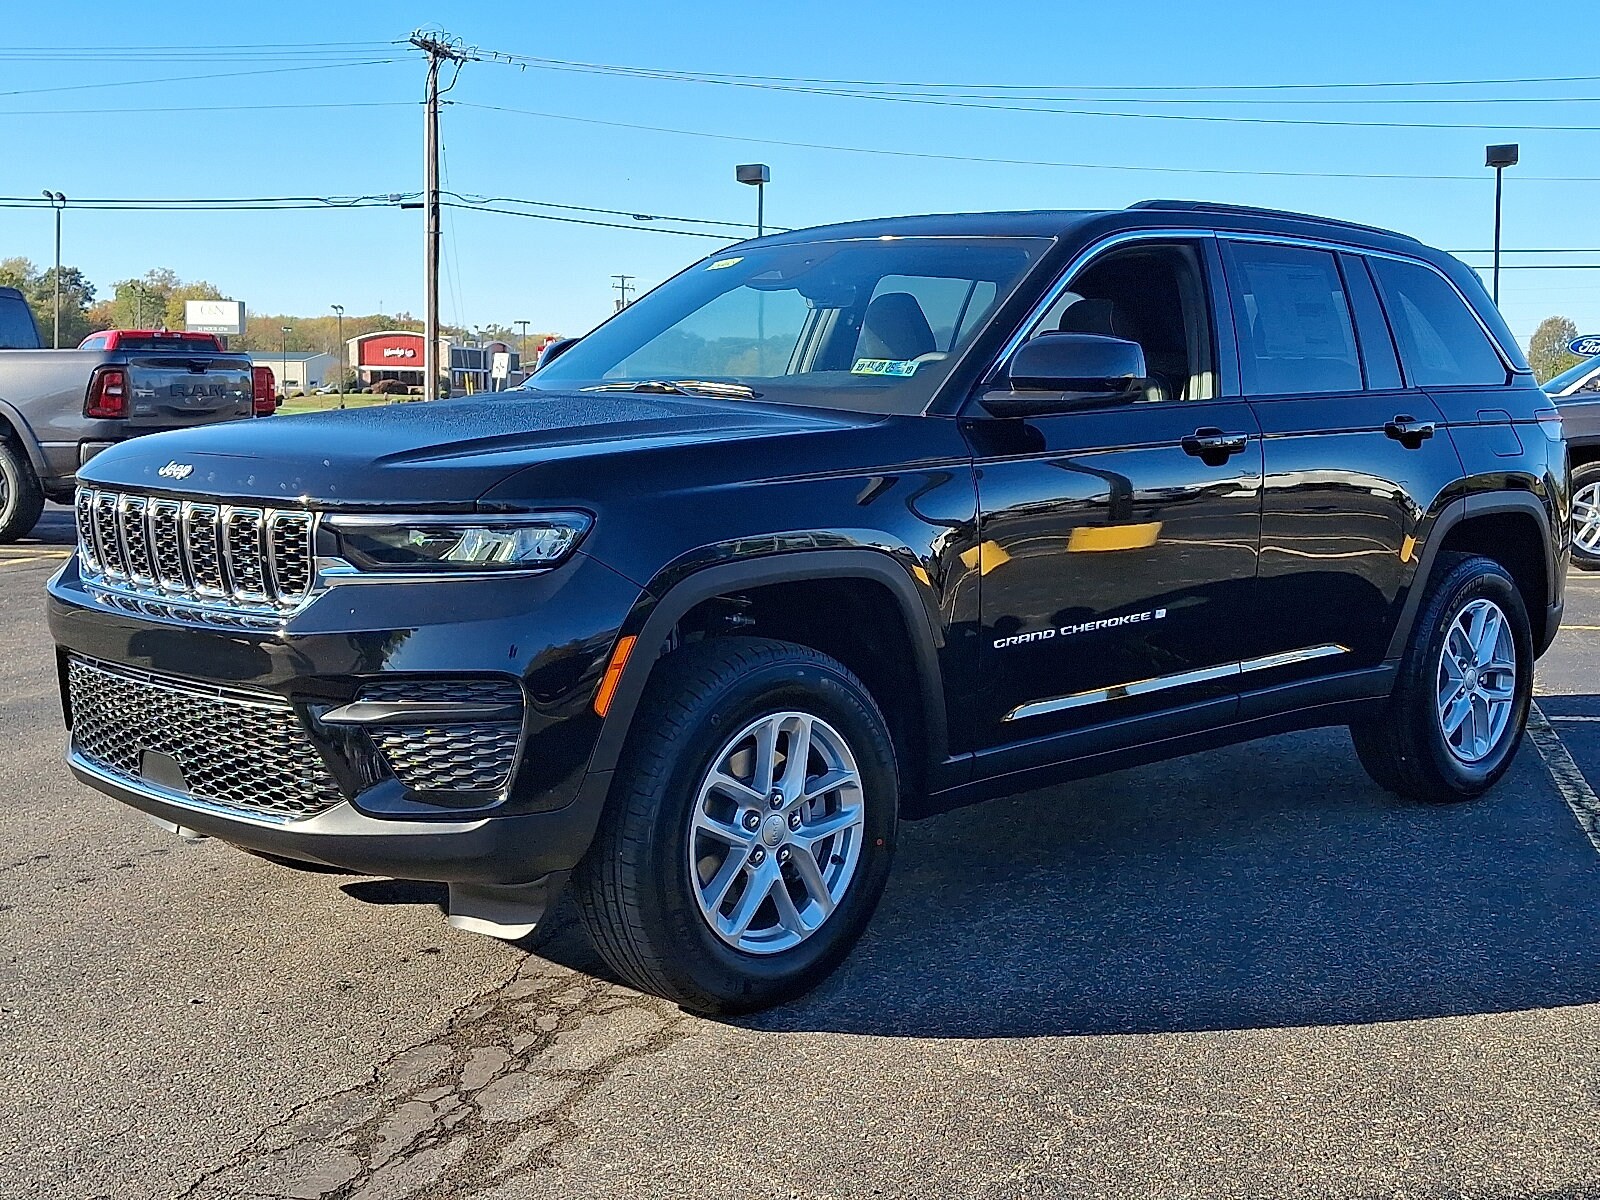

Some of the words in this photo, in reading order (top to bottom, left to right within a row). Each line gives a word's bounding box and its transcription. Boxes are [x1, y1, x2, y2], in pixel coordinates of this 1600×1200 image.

[1578, 340, 1600, 353] For
[169, 384, 226, 397] RAM
[158, 460, 194, 480] Jeep
[993, 629, 1056, 649] GRAND
[1060, 611, 1152, 636] CHEROKEE
